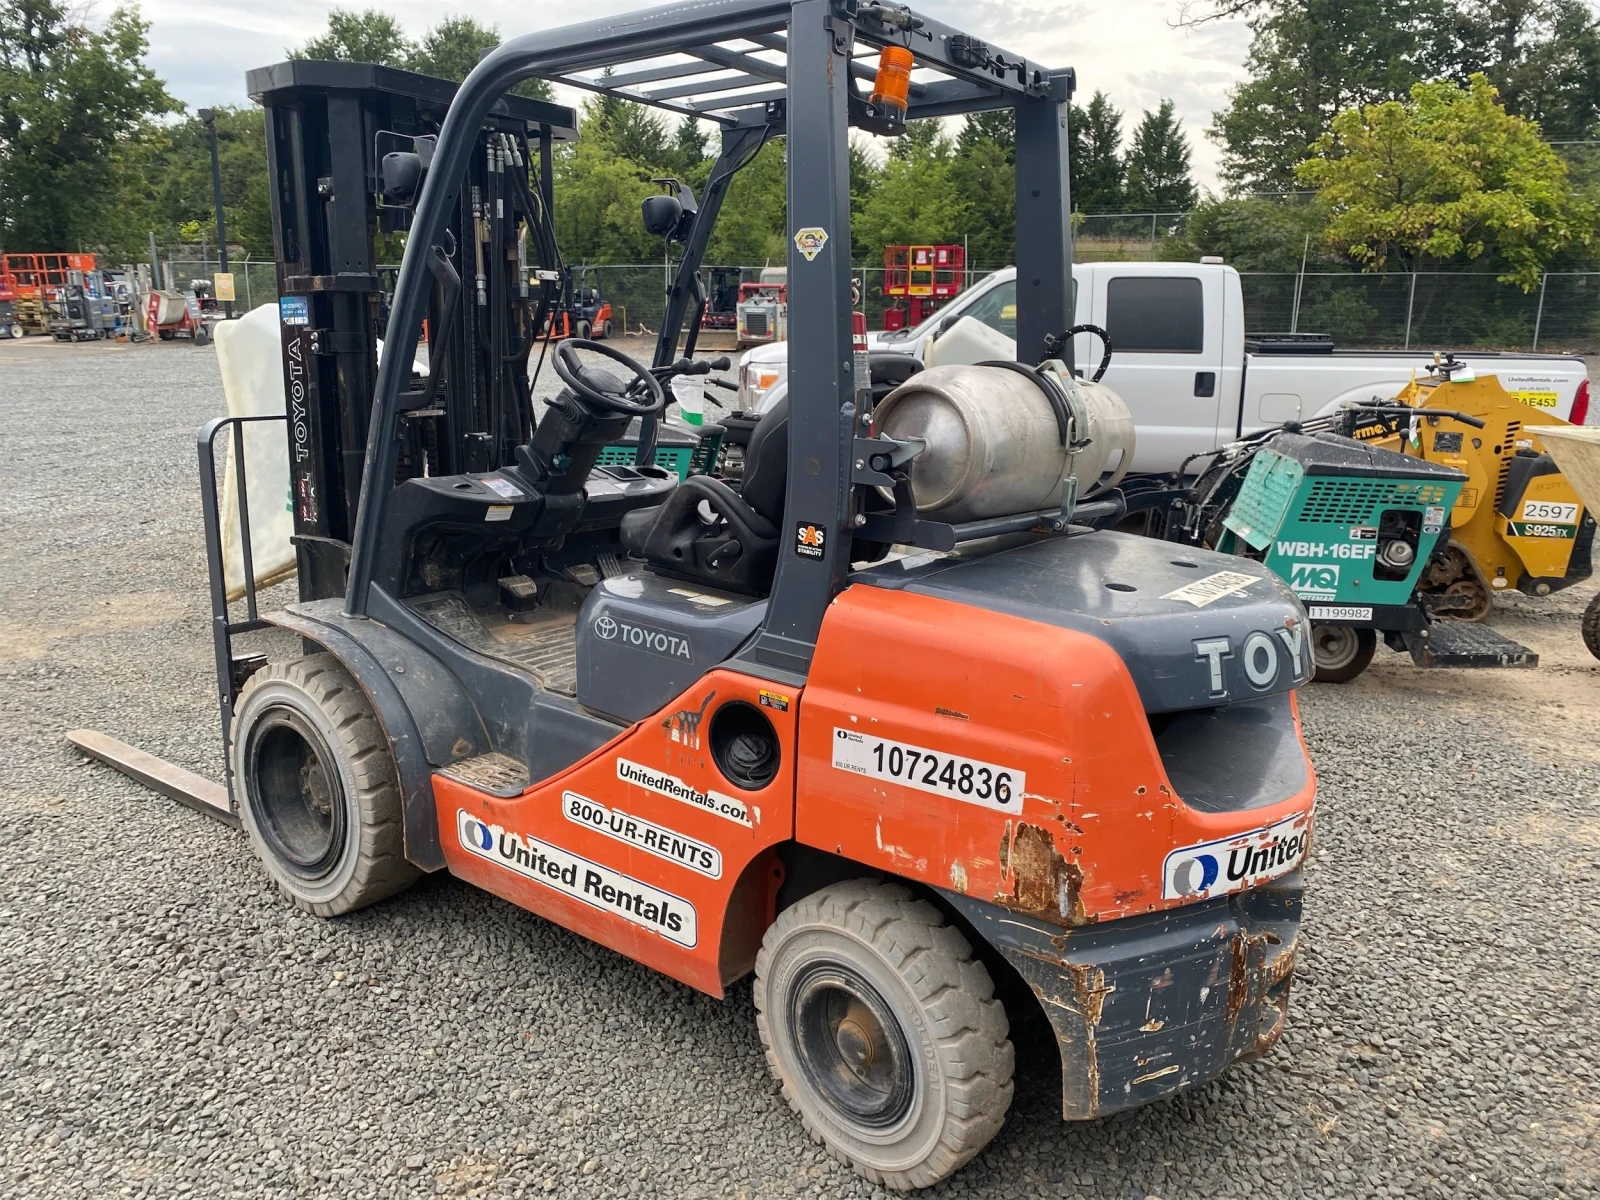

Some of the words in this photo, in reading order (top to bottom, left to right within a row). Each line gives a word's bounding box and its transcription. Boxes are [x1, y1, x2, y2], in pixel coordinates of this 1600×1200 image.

[288, 337, 309, 463] TOYOTA
[1514, 397, 1557, 408] AE453
[1524, 504, 1576, 519] 2597
[797, 526, 824, 547] SAS
[1524, 524, 1568, 537] S925TX
[1290, 566, 1339, 591] MQ
[1299, 594, 1335, 602] HITEMAN
[1311, 608, 1370, 618] 11199982
[620, 623, 691, 659] TOYOTA
[873, 742, 1012, 804] 10724836
[570, 800, 714, 870] 800-UR-RENTS
[499, 833, 577, 888] United
[584, 869, 683, 932] Rentals
